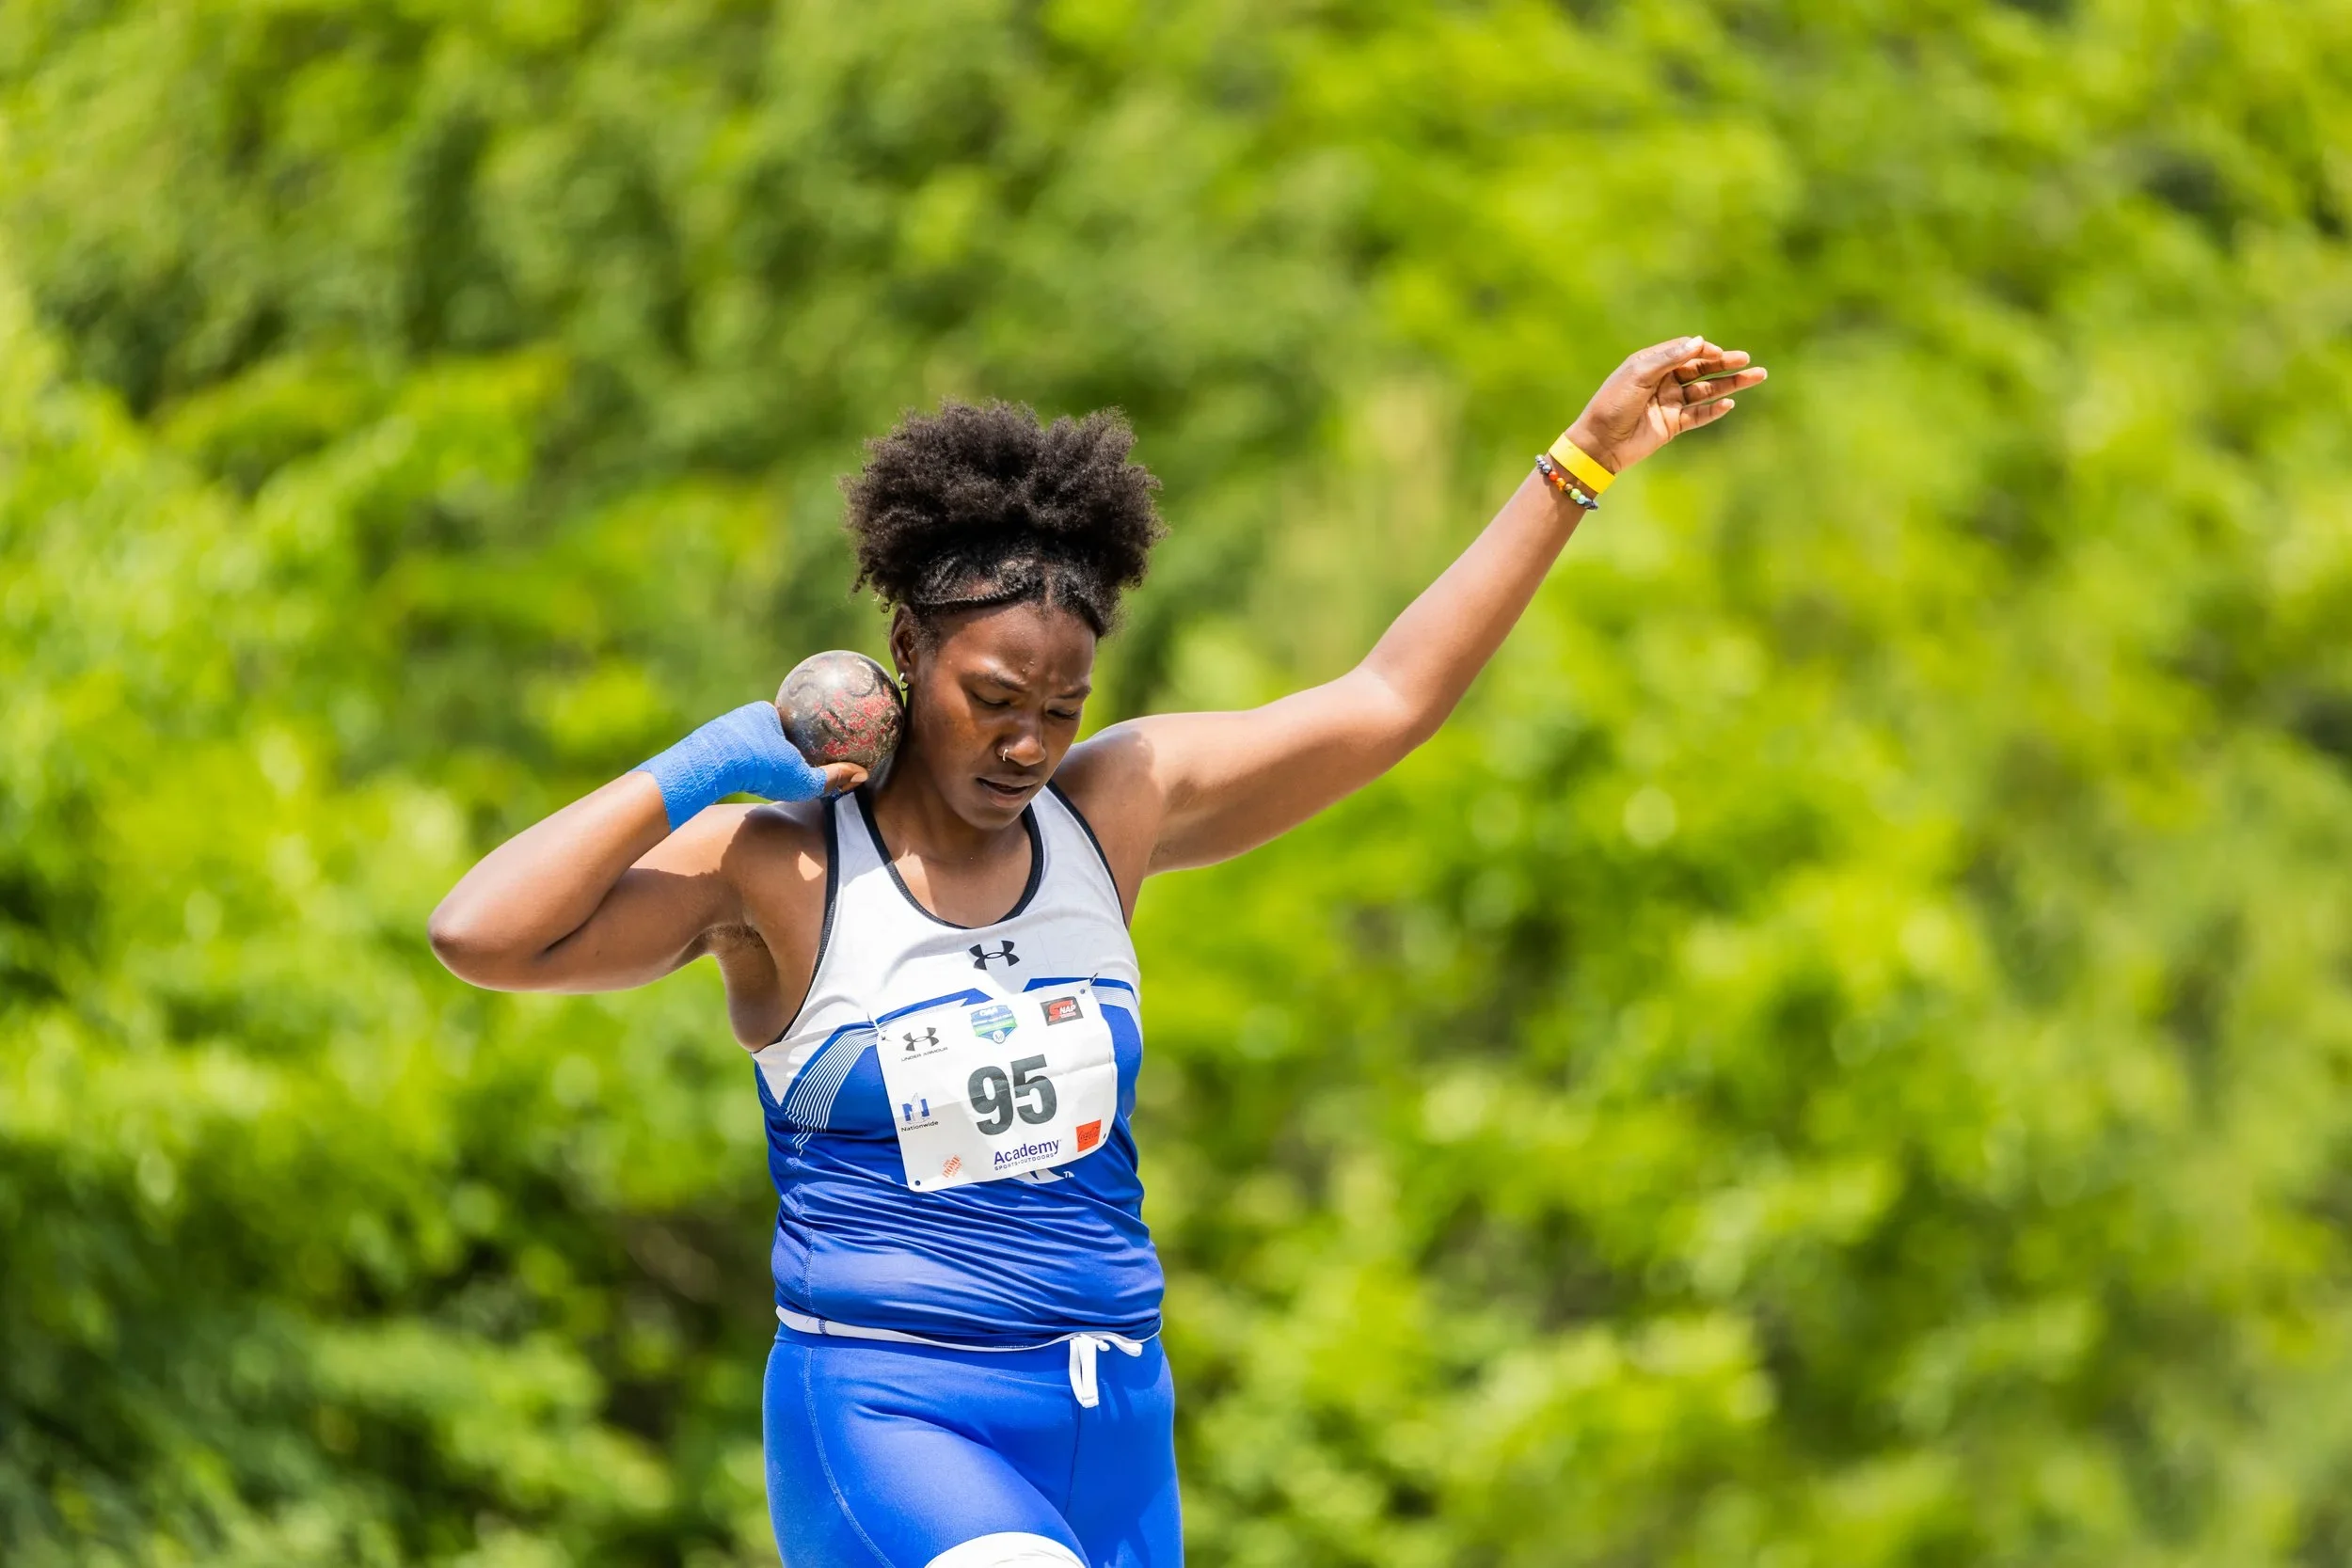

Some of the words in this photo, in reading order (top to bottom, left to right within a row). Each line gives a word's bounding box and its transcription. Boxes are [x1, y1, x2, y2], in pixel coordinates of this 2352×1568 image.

[967, 1053, 1057, 1135] 95
[900, 1120, 939, 1132] Nationwide
[993, 1139, 1060, 1165] Academy
